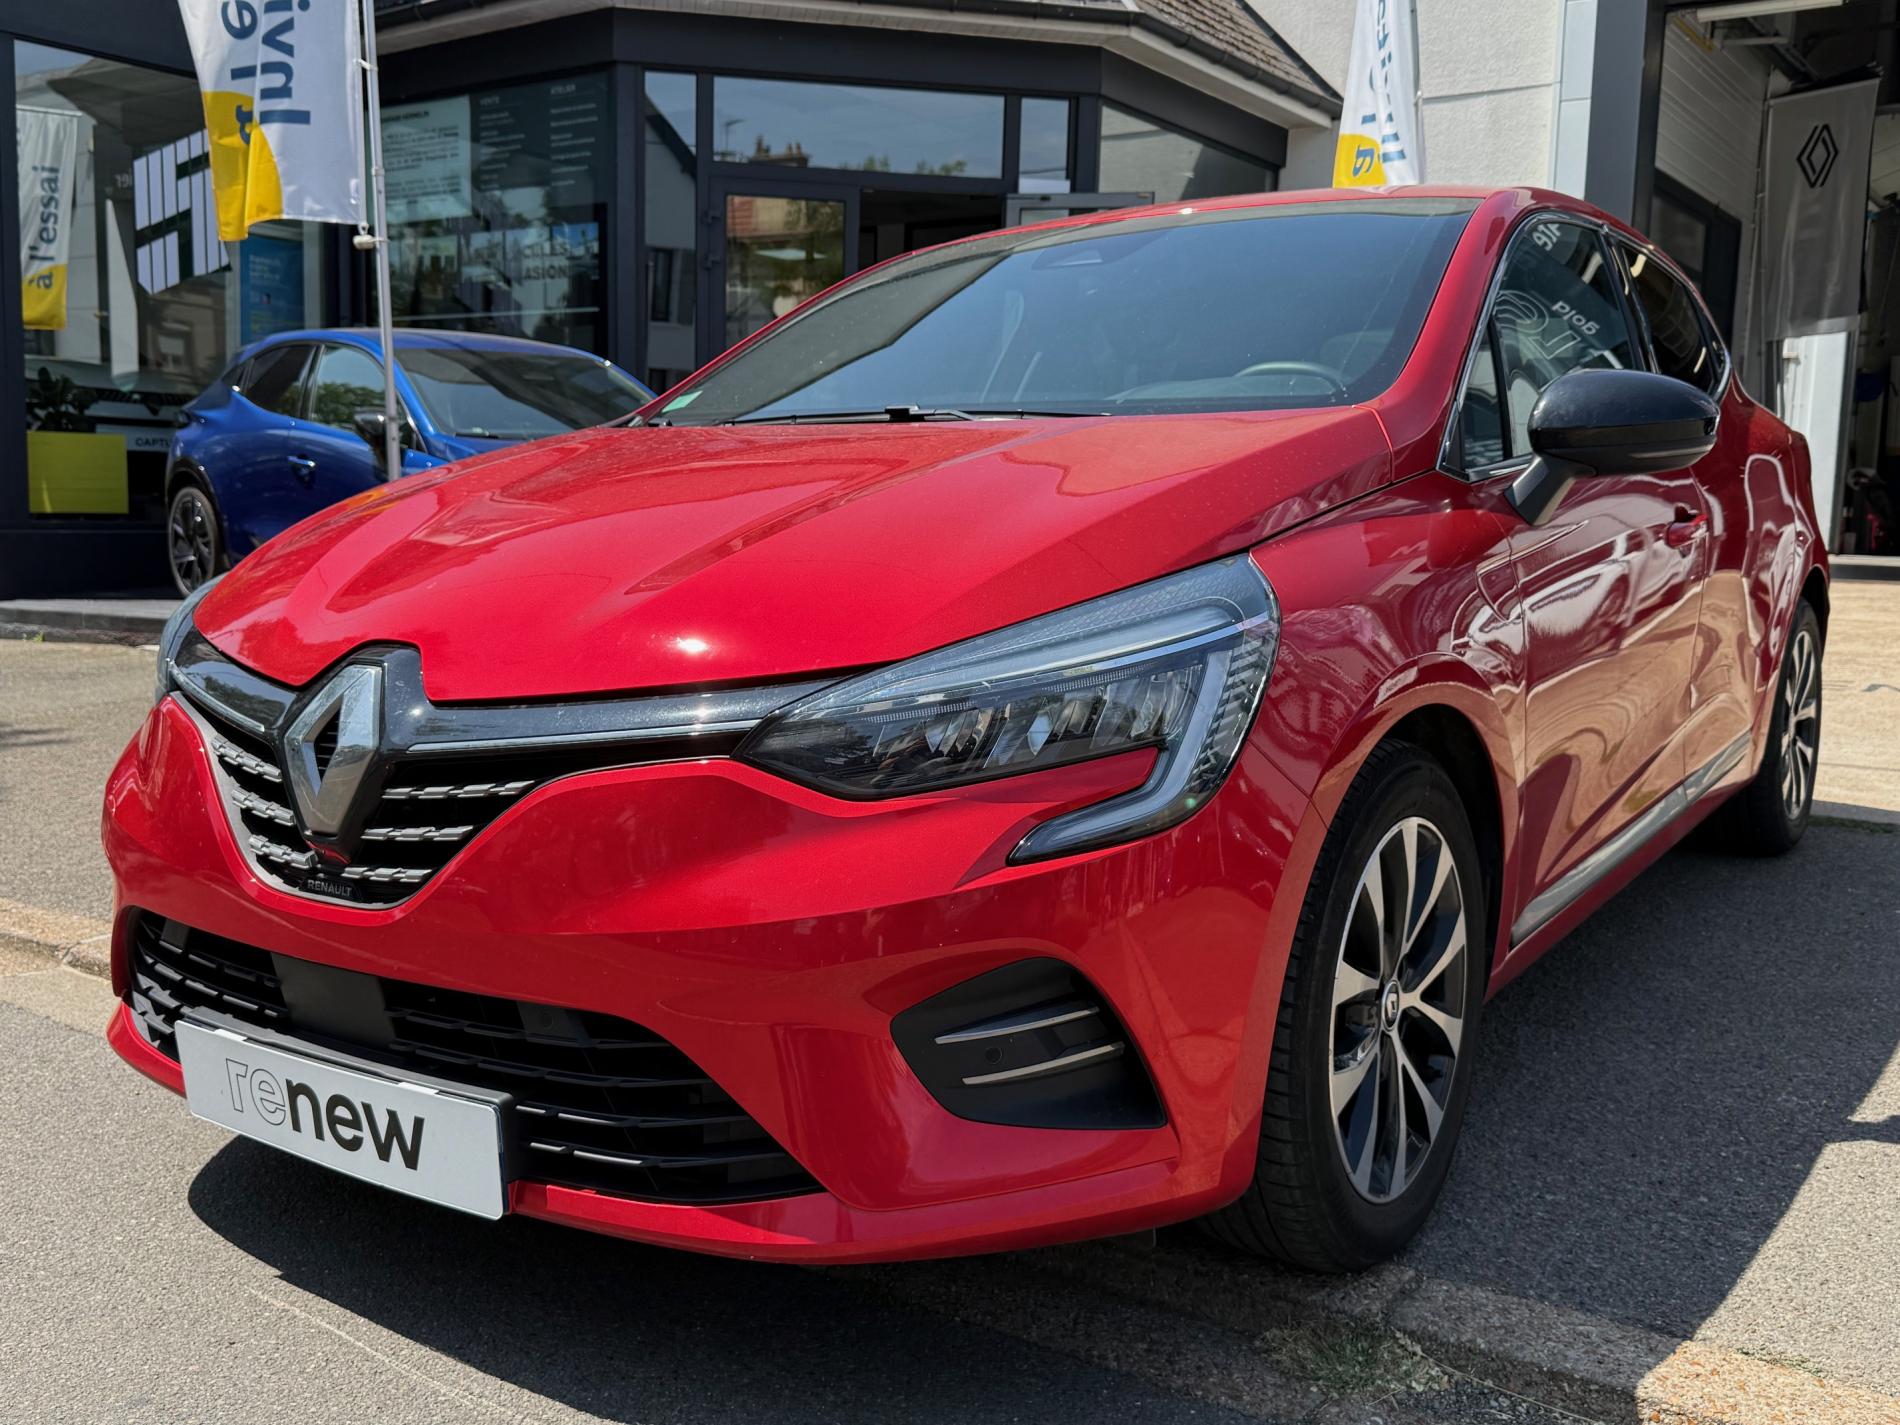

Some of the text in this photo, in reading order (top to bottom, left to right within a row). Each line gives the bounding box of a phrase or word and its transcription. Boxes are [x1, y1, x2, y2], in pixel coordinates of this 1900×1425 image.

[28, 164, 61, 261] l'essai
[307, 879, 352, 897] RENAULT
[225, 1058, 425, 1171] renew
